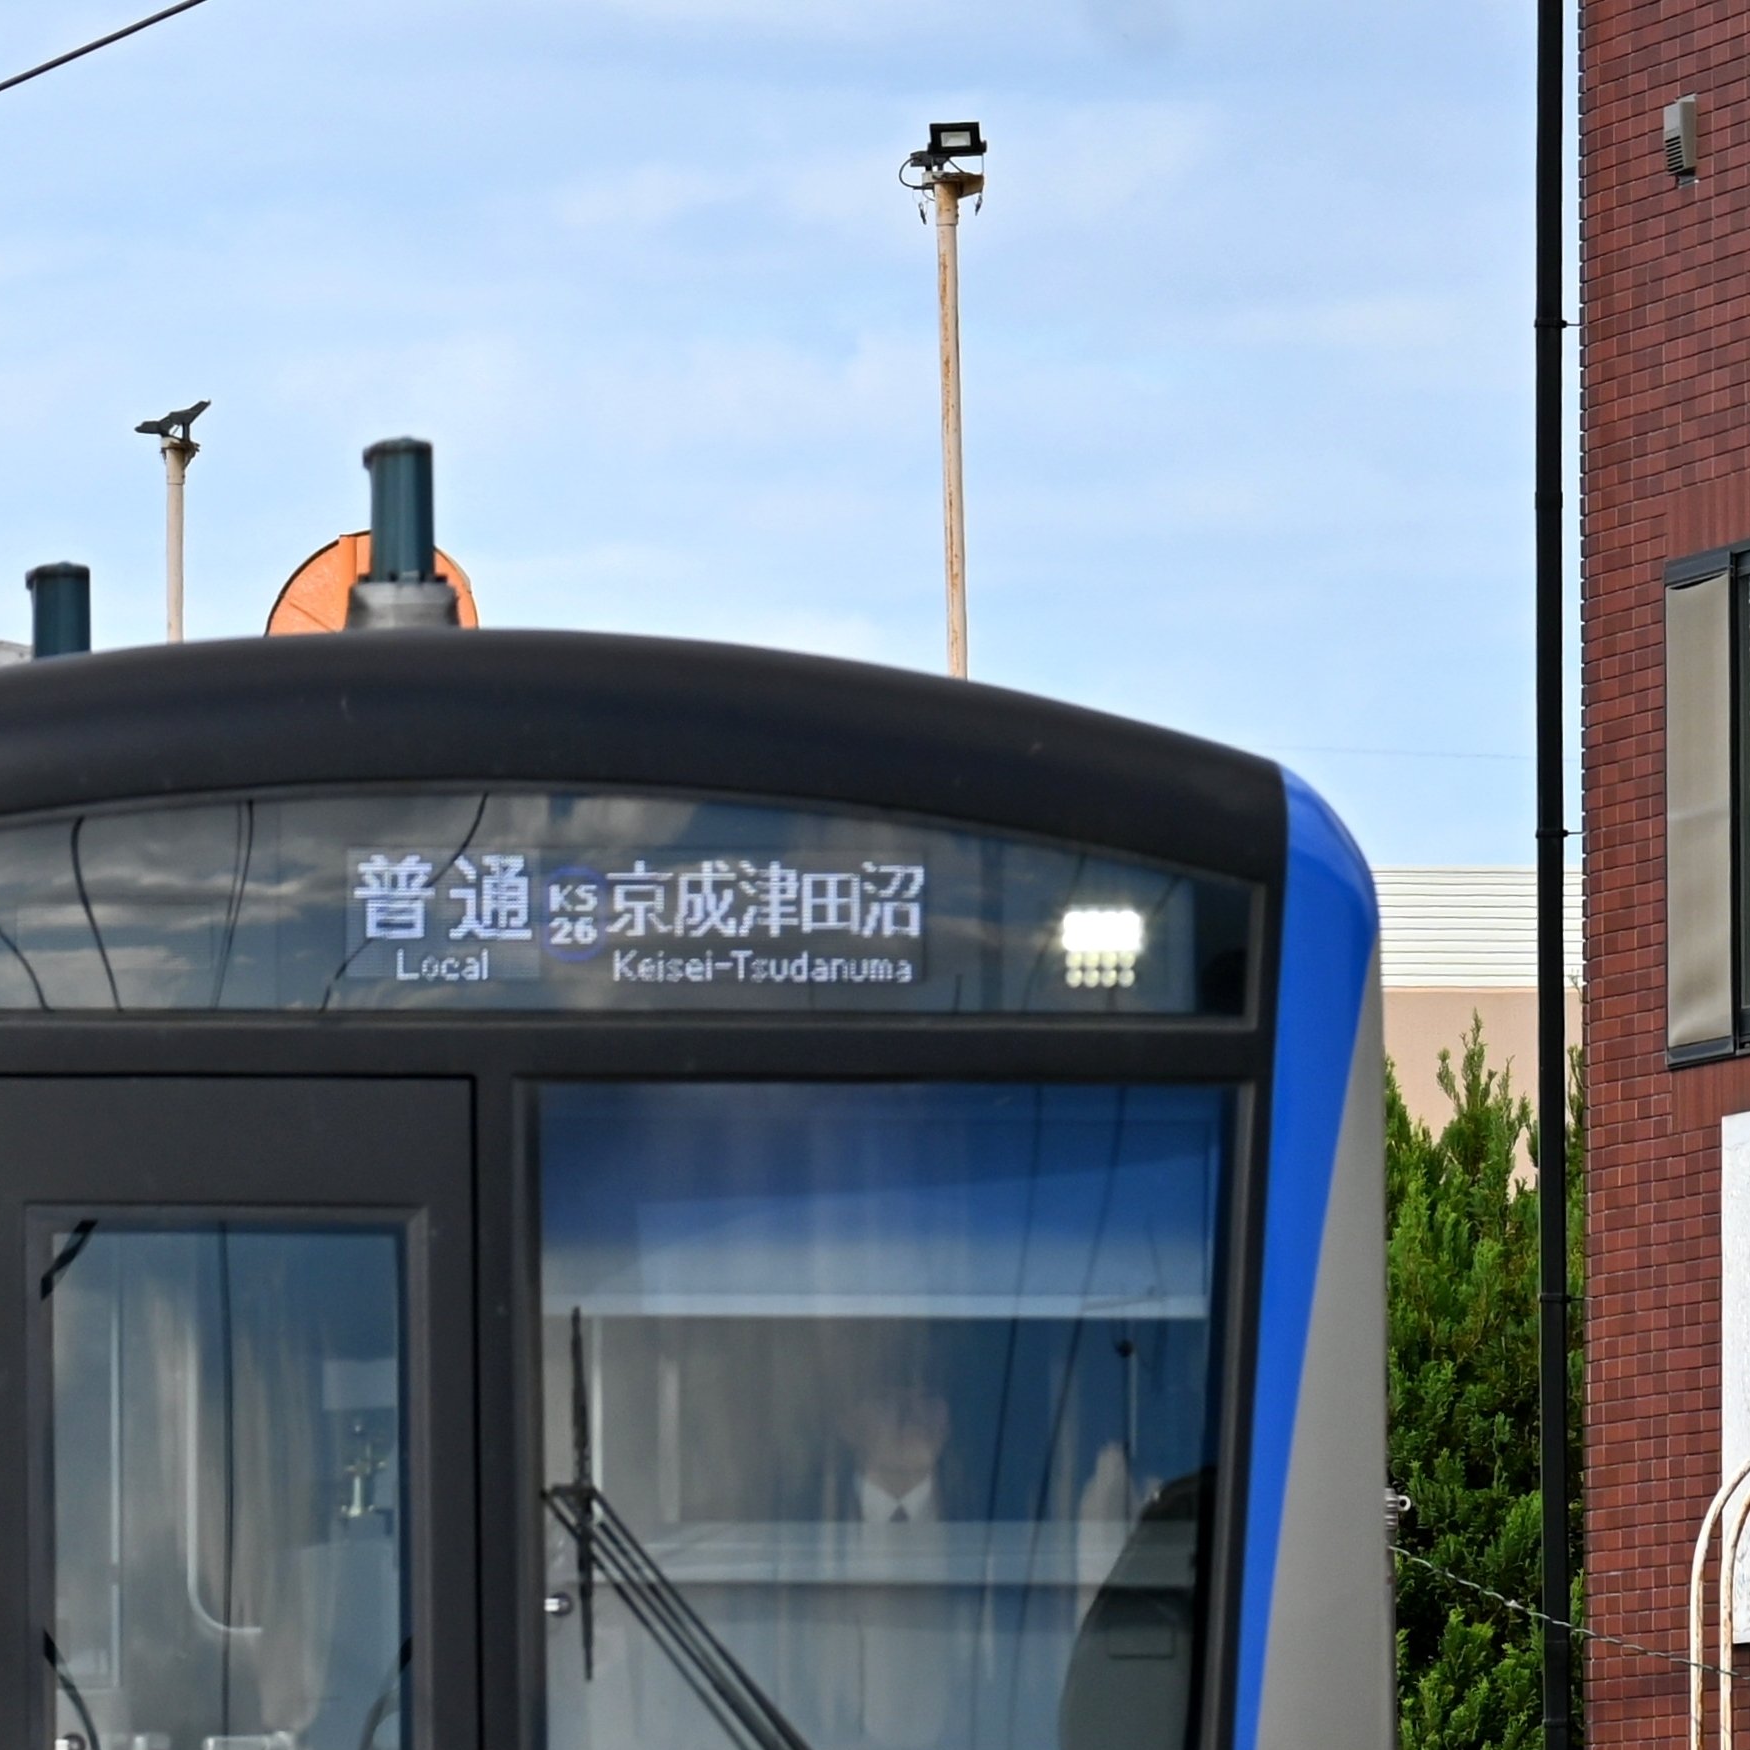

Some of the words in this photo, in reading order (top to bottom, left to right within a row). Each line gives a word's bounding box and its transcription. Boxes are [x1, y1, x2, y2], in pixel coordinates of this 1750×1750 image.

[354, 855, 533, 940] 普通
[549, 884, 598, 912] KS
[605, 860, 925, 938] 京成津田沼
[549, 917, 596, 945] 26
[396, 949, 489, 981] Local
[612, 950, 912, 983] Keisei-Tsudanuma
